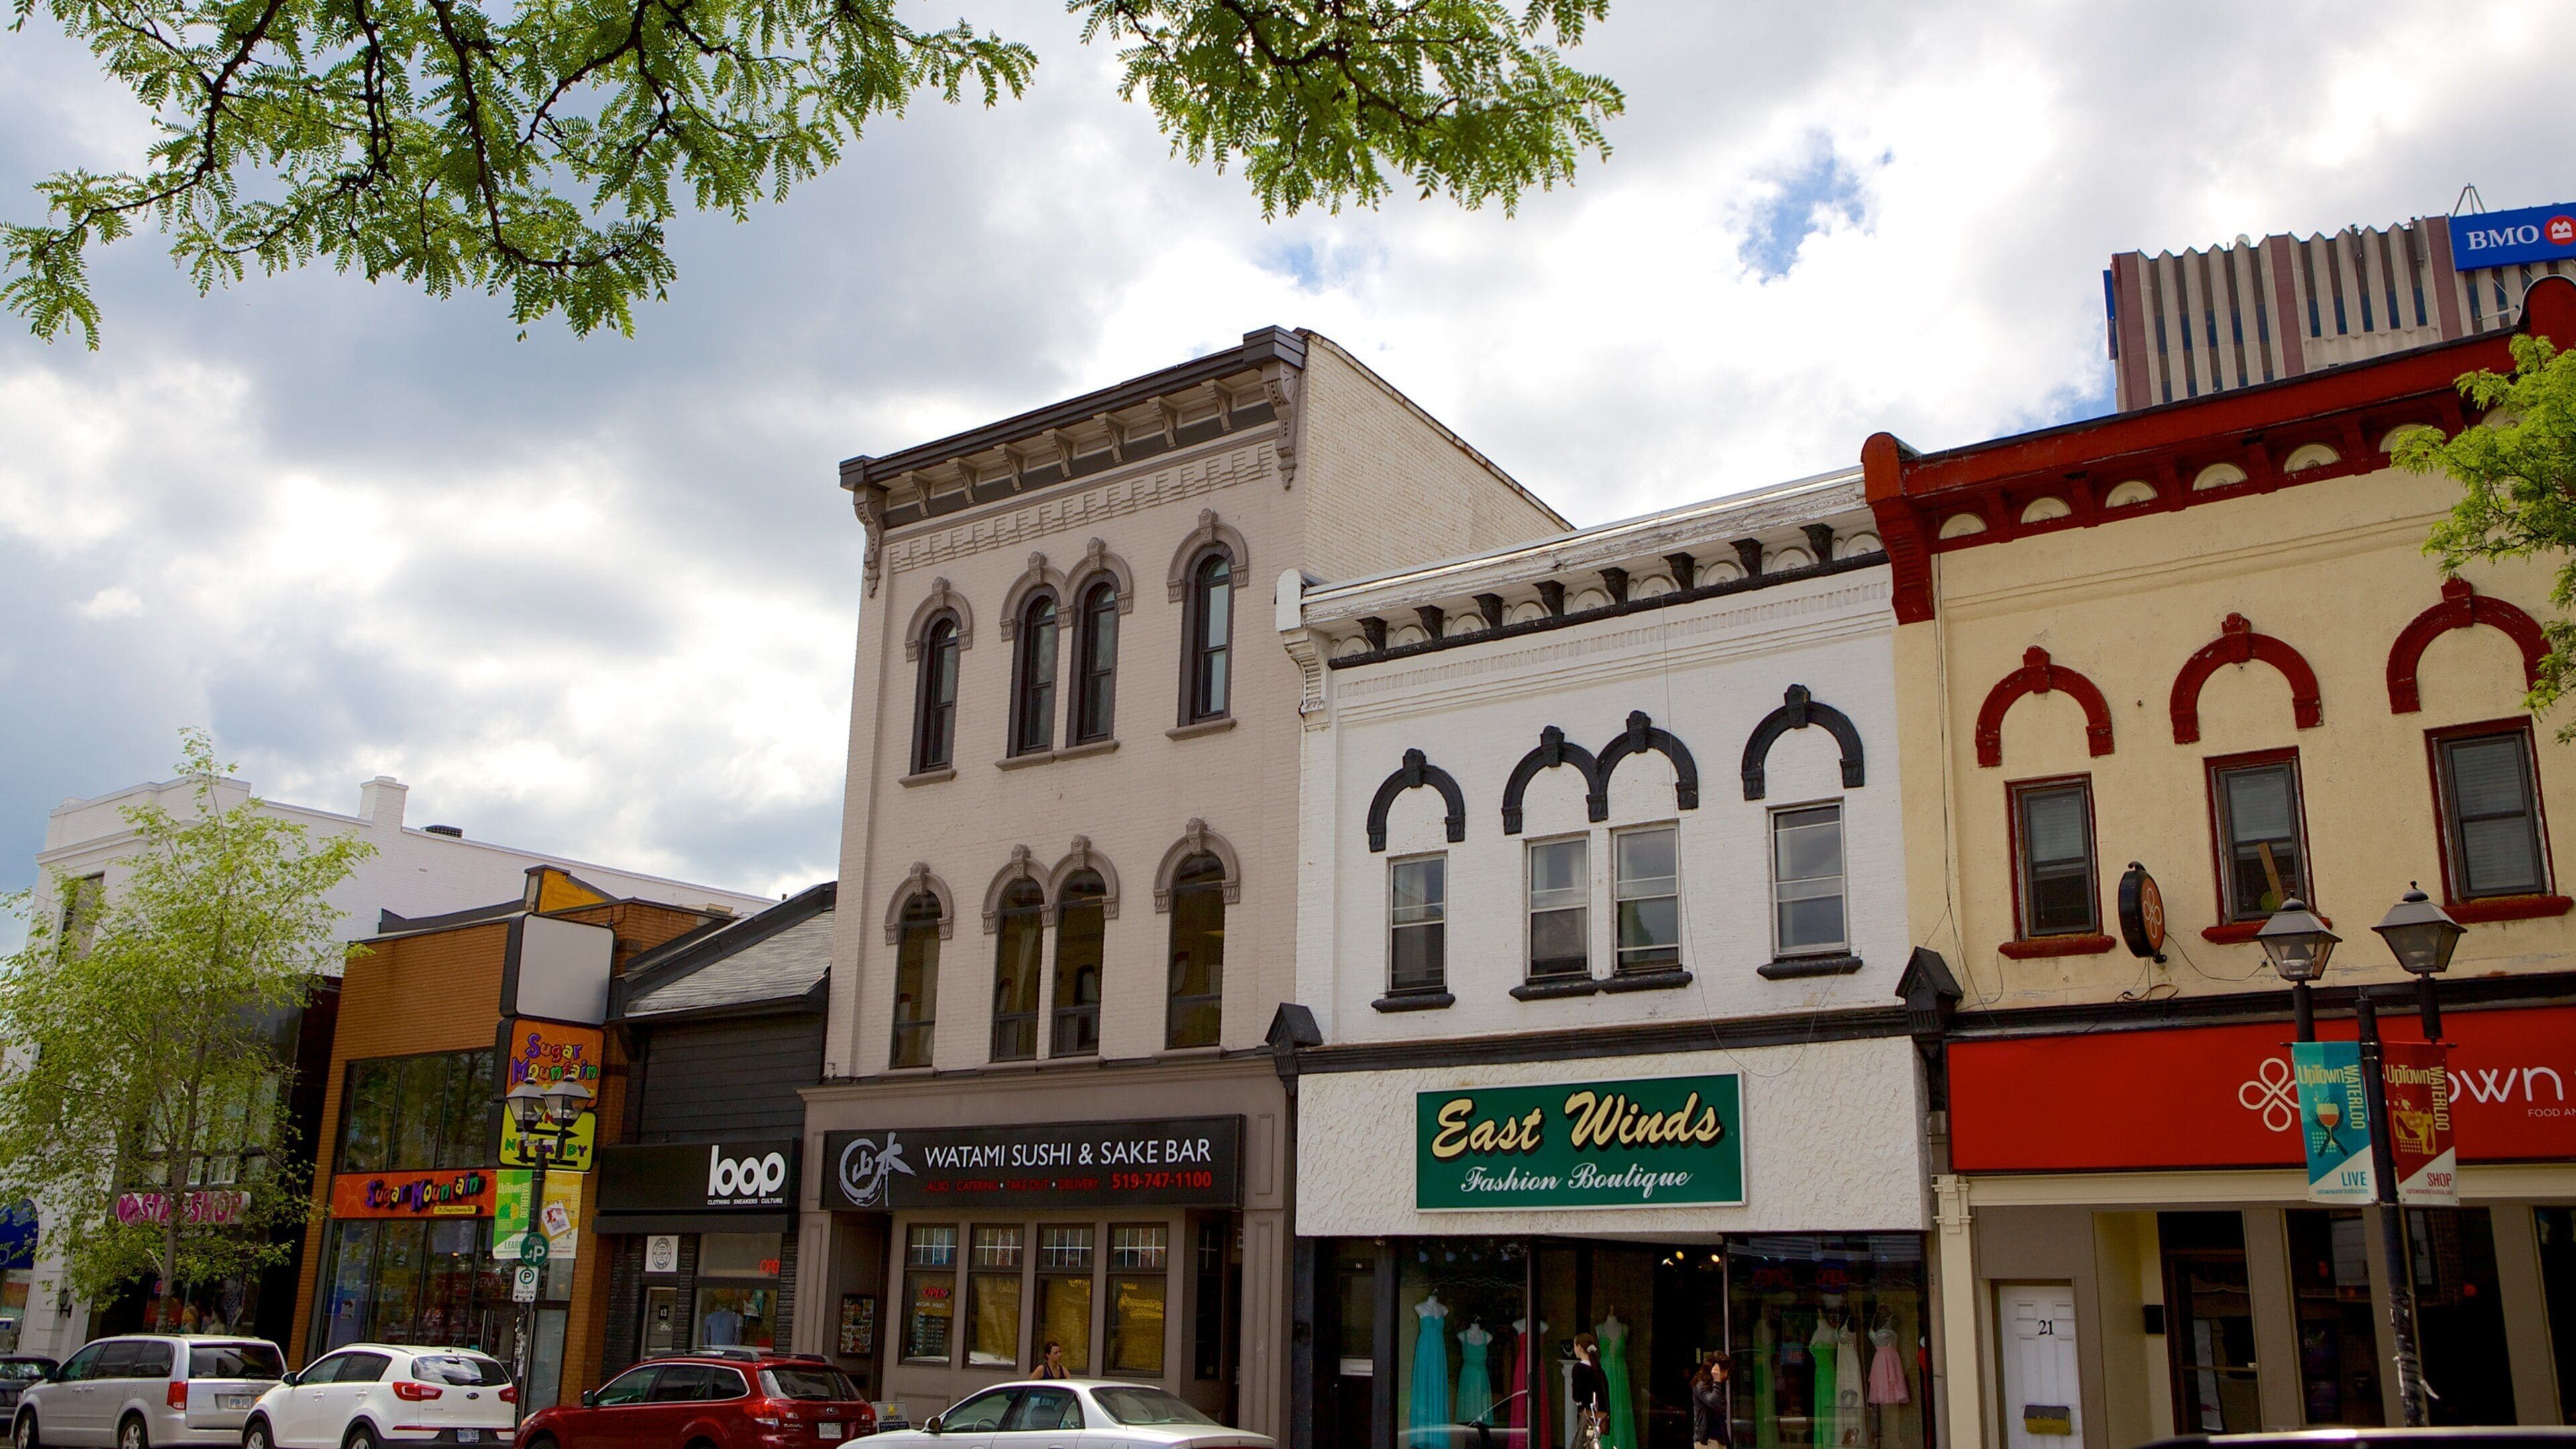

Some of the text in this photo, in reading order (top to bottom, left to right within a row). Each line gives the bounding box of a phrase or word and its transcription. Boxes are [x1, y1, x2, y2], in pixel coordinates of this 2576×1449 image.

[2466, 225, 2540, 251] BMO
[525, 1034, 583, 1063] Sugar
[511, 1057, 598, 1086] Mountain
[2297, 1065, 2345, 1087] UpTown
[2385, 1064, 2432, 1087] UpTown
[2343, 1065, 2366, 1130] WATERLOO
[2429, 1066, 2451, 1131] WATERLOO
[2528, 1108, 2561, 1117] FOOD
[1432, 1090, 1721, 1159] East Winds
[924, 1138, 1212, 1168] WATAMI SUSHI & SAKE BAR
[707, 1144, 786, 1197] loop
[1111, 1171, 1212, 1190] 519-747-1100
[1460, 1162, 1695, 1199] Fashion Boutique
[2341, 1171, 2367, 1187] LIVE
[2426, 1172, 2453, 1187] SHOP
[365, 1171, 480, 1213] Sugar Mountain
[498, 1182, 522, 1195] UpTown
[955, 1179, 998, 1191] CATERING
[1058, 1177, 1099, 1190] DELIVERY
[519, 1182, 531, 1218] WATERLOO
[533, 1246, 545, 1263] P
[523, 1273, 531, 1281] P
[922, 1287, 949, 1299] OPEN
[2038, 1320, 2054, 1336] 21
